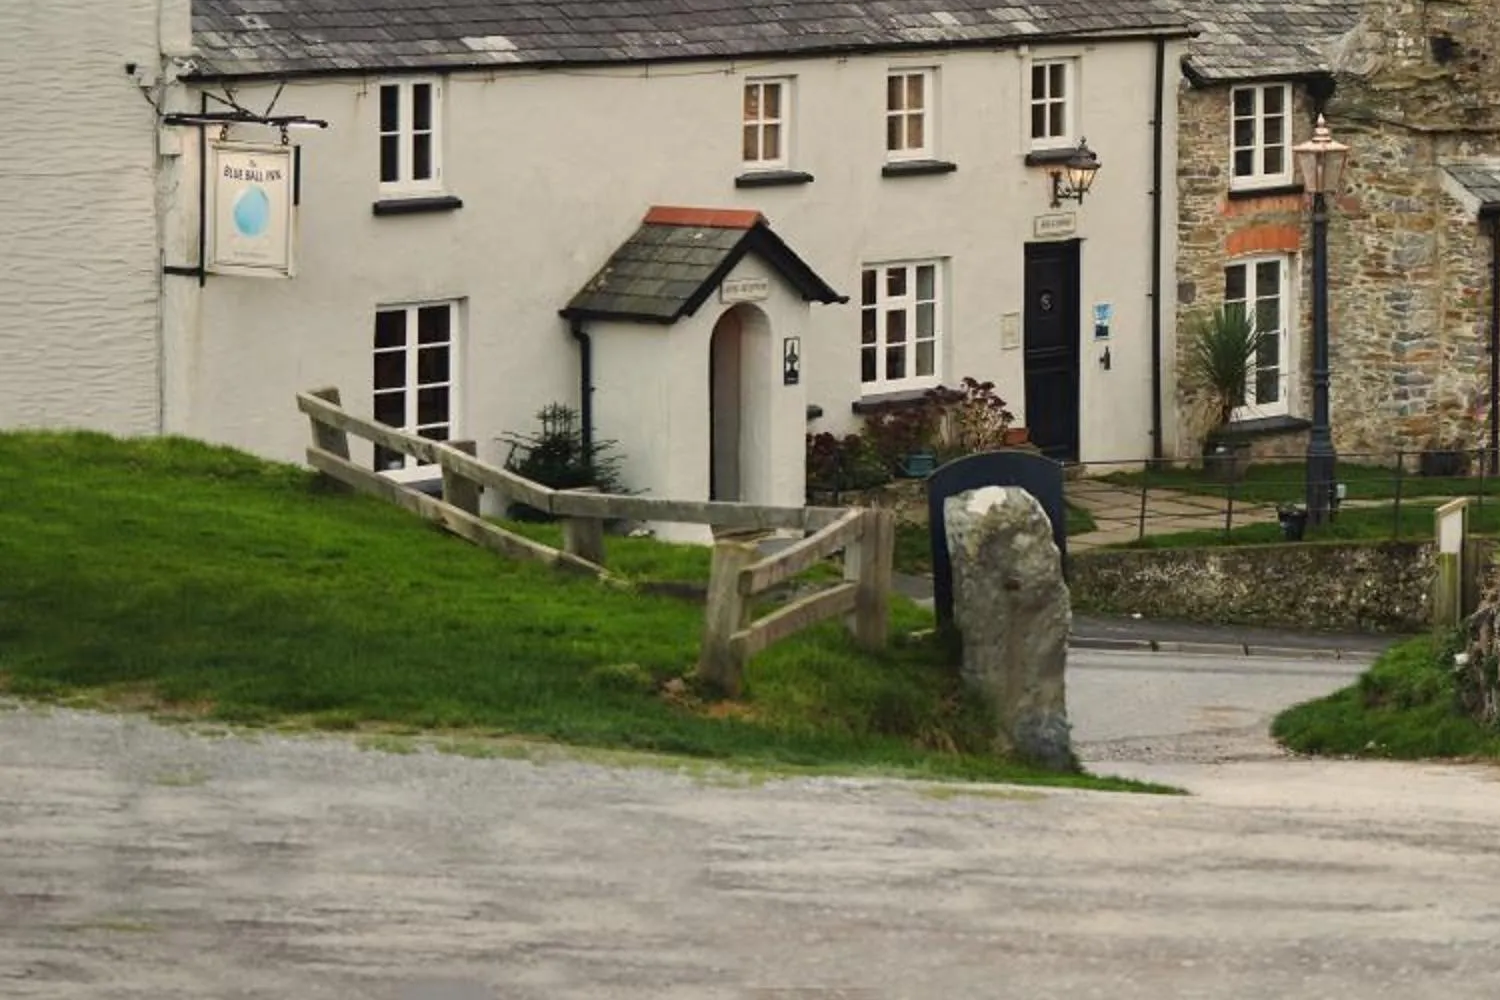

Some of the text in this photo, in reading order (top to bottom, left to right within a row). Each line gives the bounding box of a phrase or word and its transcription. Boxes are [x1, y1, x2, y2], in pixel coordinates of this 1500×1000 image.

[223, 165, 282, 182] BLUE BALL INN
